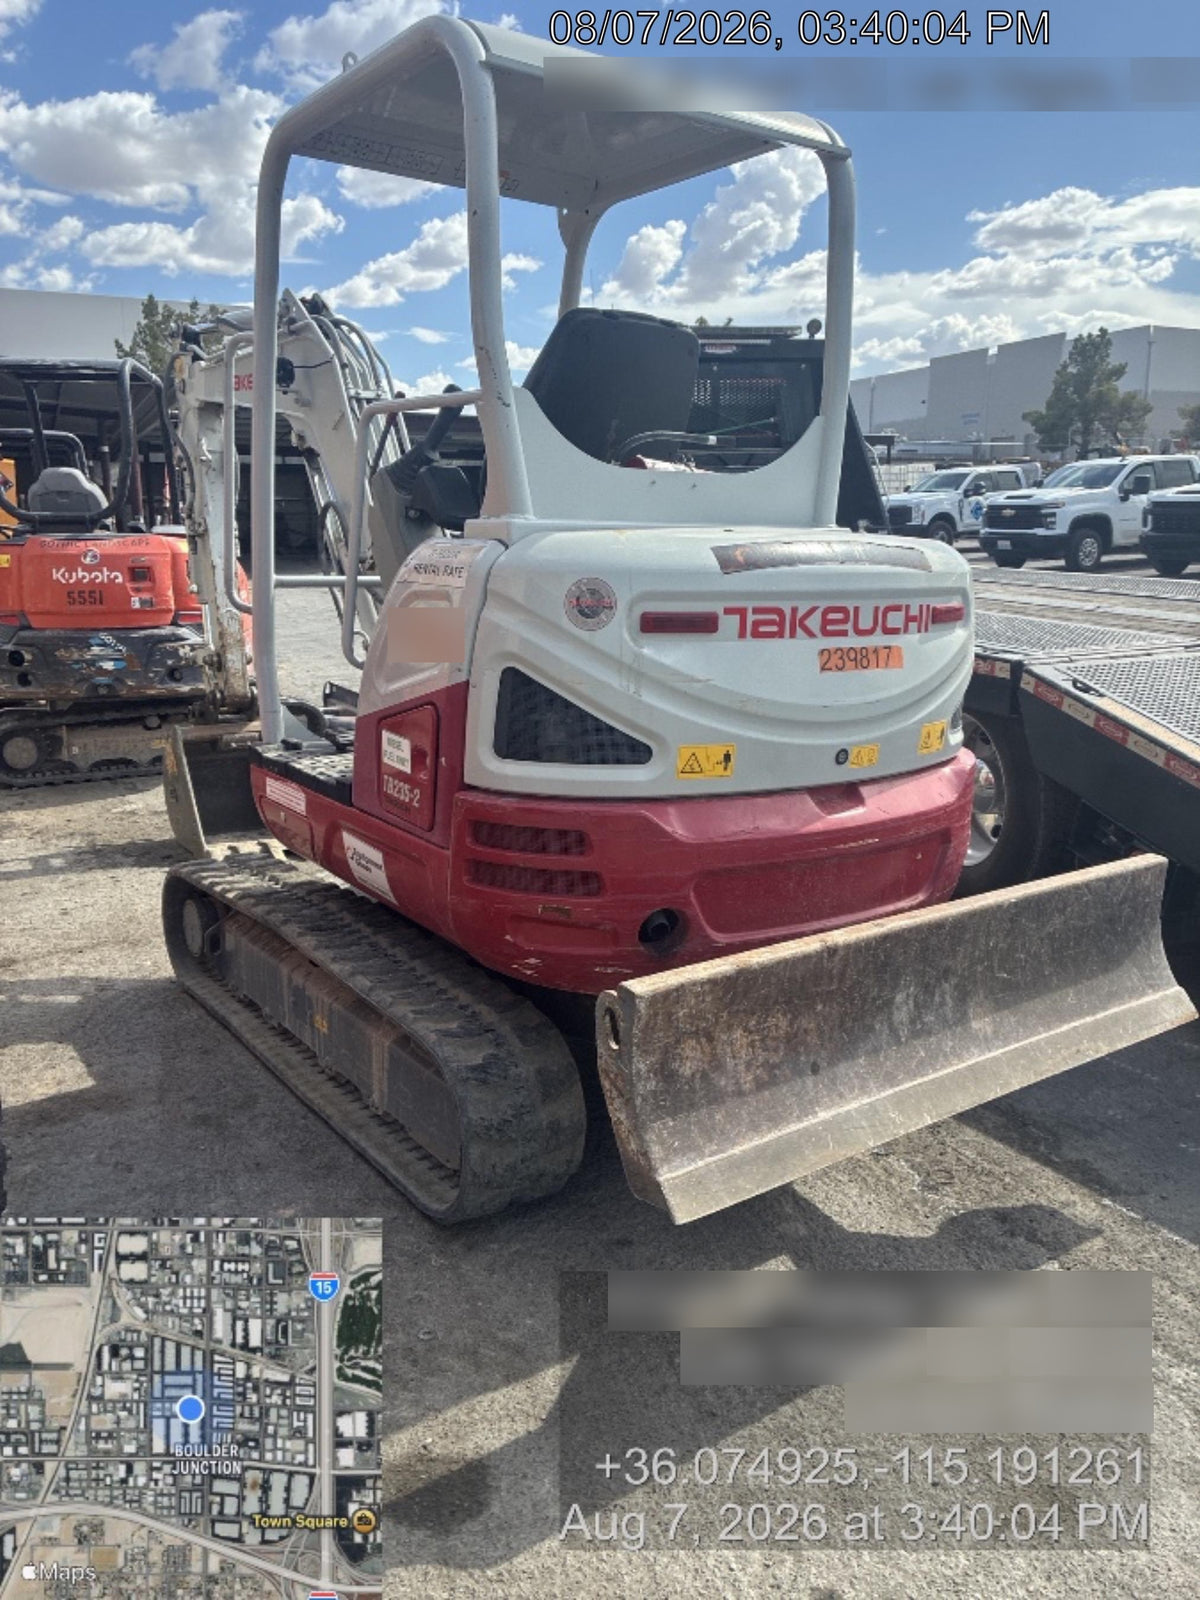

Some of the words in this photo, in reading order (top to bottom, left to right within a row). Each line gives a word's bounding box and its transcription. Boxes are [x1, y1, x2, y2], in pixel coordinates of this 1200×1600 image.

[51, 566, 123, 584] Kubota
[66, 589, 104, 606] 5551
[820, 645, 892, 672] 239817
